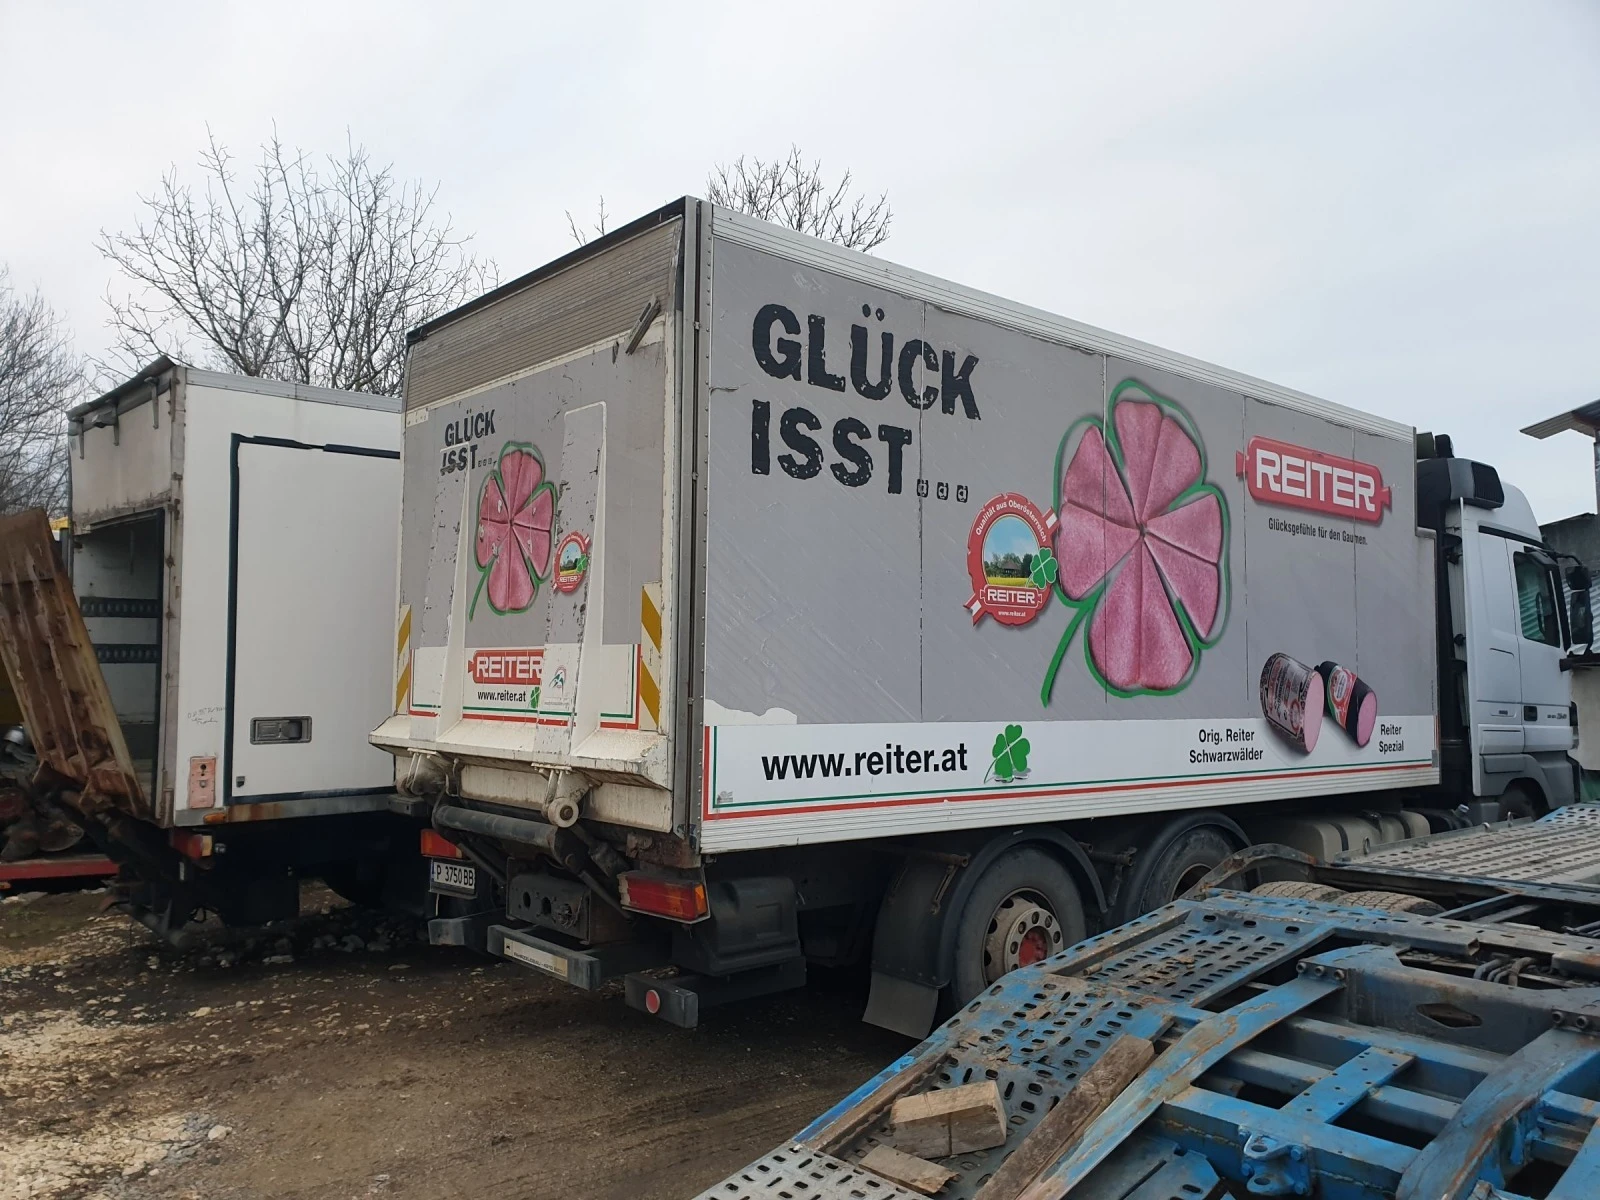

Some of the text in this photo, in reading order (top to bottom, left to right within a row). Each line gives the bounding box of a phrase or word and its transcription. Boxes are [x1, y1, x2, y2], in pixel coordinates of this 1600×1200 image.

[752, 303, 981, 420] GLÜCK
[444, 408, 496, 447] GLÜCK
[1256, 448, 1375, 512] REITER
[975, 499, 1047, 542] Qualität aus Oberösterreich
[1268, 517, 1316, 536] Glücksgefühle
[1318, 526, 1327, 539] für
[1329, 529, 1340, 541] den
[987, 588, 1036, 604] REITER
[476, 656, 543, 679] REITER
[477, 689, 527, 703] www.reiter.at
[1199, 728, 1255, 745] Orig. Reiter
[1380, 724, 1402, 736] Reiter
[1189, 748, 1263, 764] Schwarzwälder
[1379, 741, 1404, 755] Spezial
[761, 743, 968, 781] www.reiter.at
